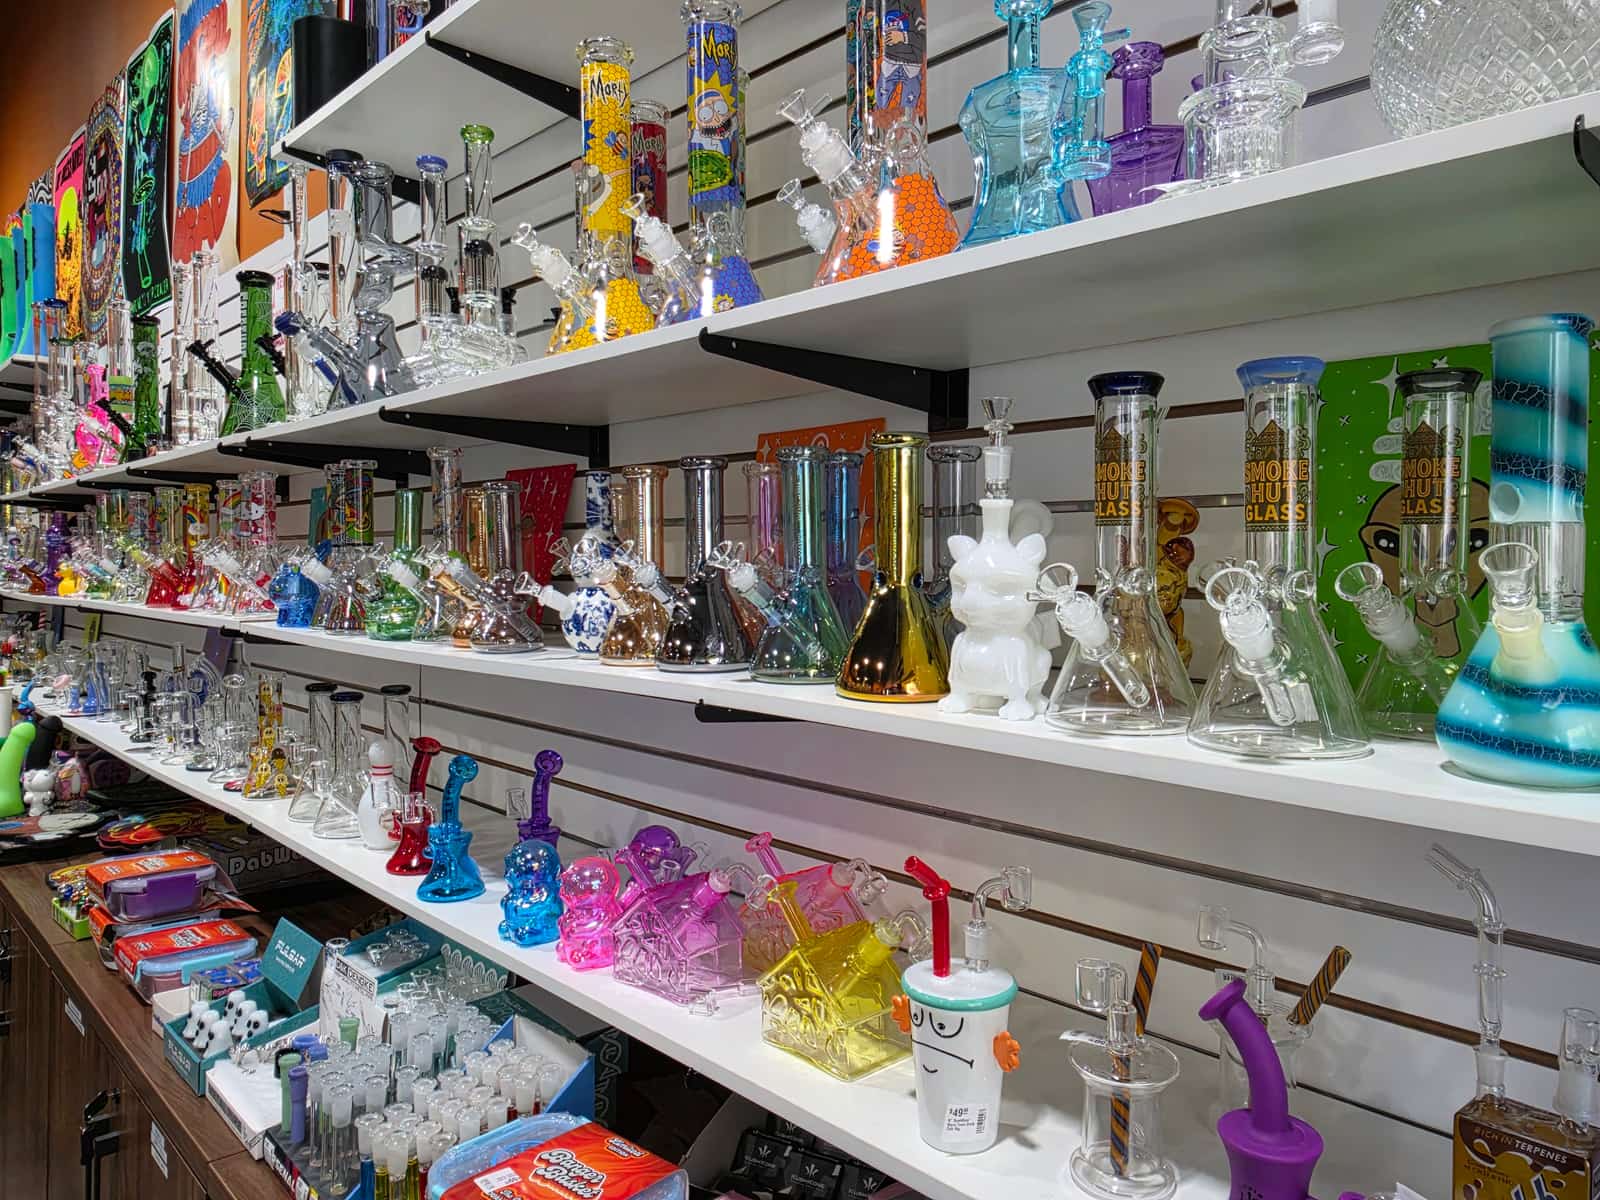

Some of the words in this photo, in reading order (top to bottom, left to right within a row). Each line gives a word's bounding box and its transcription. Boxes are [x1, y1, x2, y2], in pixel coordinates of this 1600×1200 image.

[703, 28, 738, 71] Morty
[589, 68, 630, 108] Morty
[632, 127, 665, 160] Morty
[1096, 462, 1146, 481] MOKE
[1244, 459, 1309, 483] SMOKE
[1405, 457, 1461, 478] MOKE
[1097, 482, 1134, 501] HUT
[1251, 482, 1297, 503] HUT
[1405, 478, 1446, 498] HUT
[1246, 504, 1306, 521] GLASS
[1515, 1140, 1568, 1164] TERPENES
[539, 1149, 605, 1183] Banger
[535, 1165, 602, 1200] Basket
